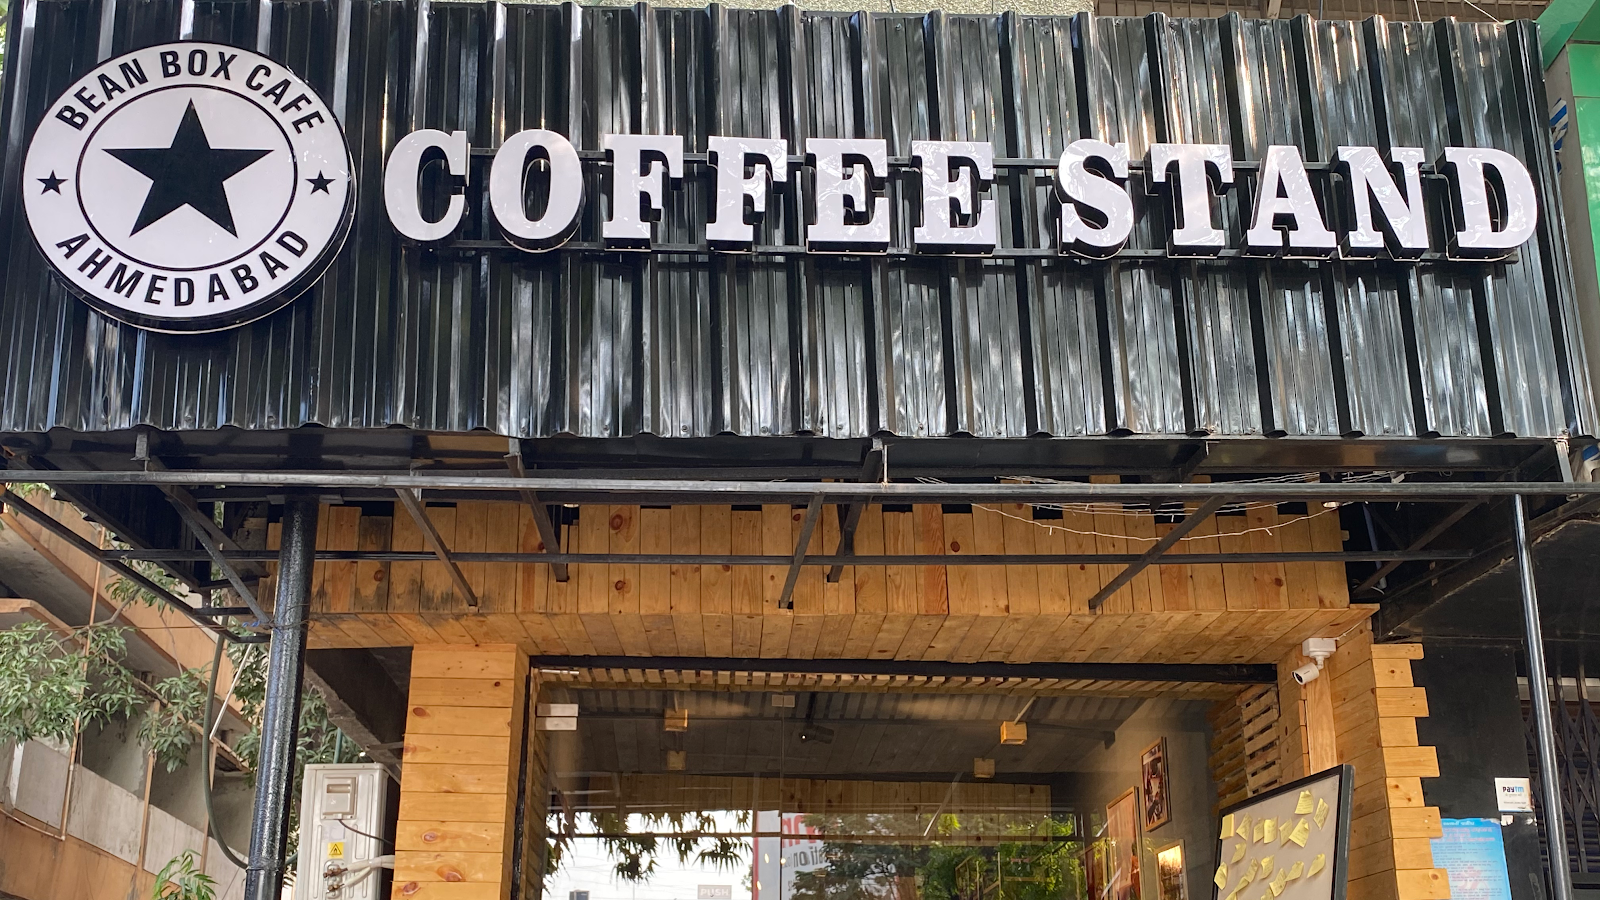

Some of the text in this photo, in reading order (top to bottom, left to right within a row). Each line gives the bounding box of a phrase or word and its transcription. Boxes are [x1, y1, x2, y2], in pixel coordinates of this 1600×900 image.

[55, 49, 325, 134] BEAN BOX CAFE
[384, 129, 1538, 258] COFFEE STAND
[56, 230, 309, 307] AHMEDABAD
[700, 888, 729, 896] PUSH
